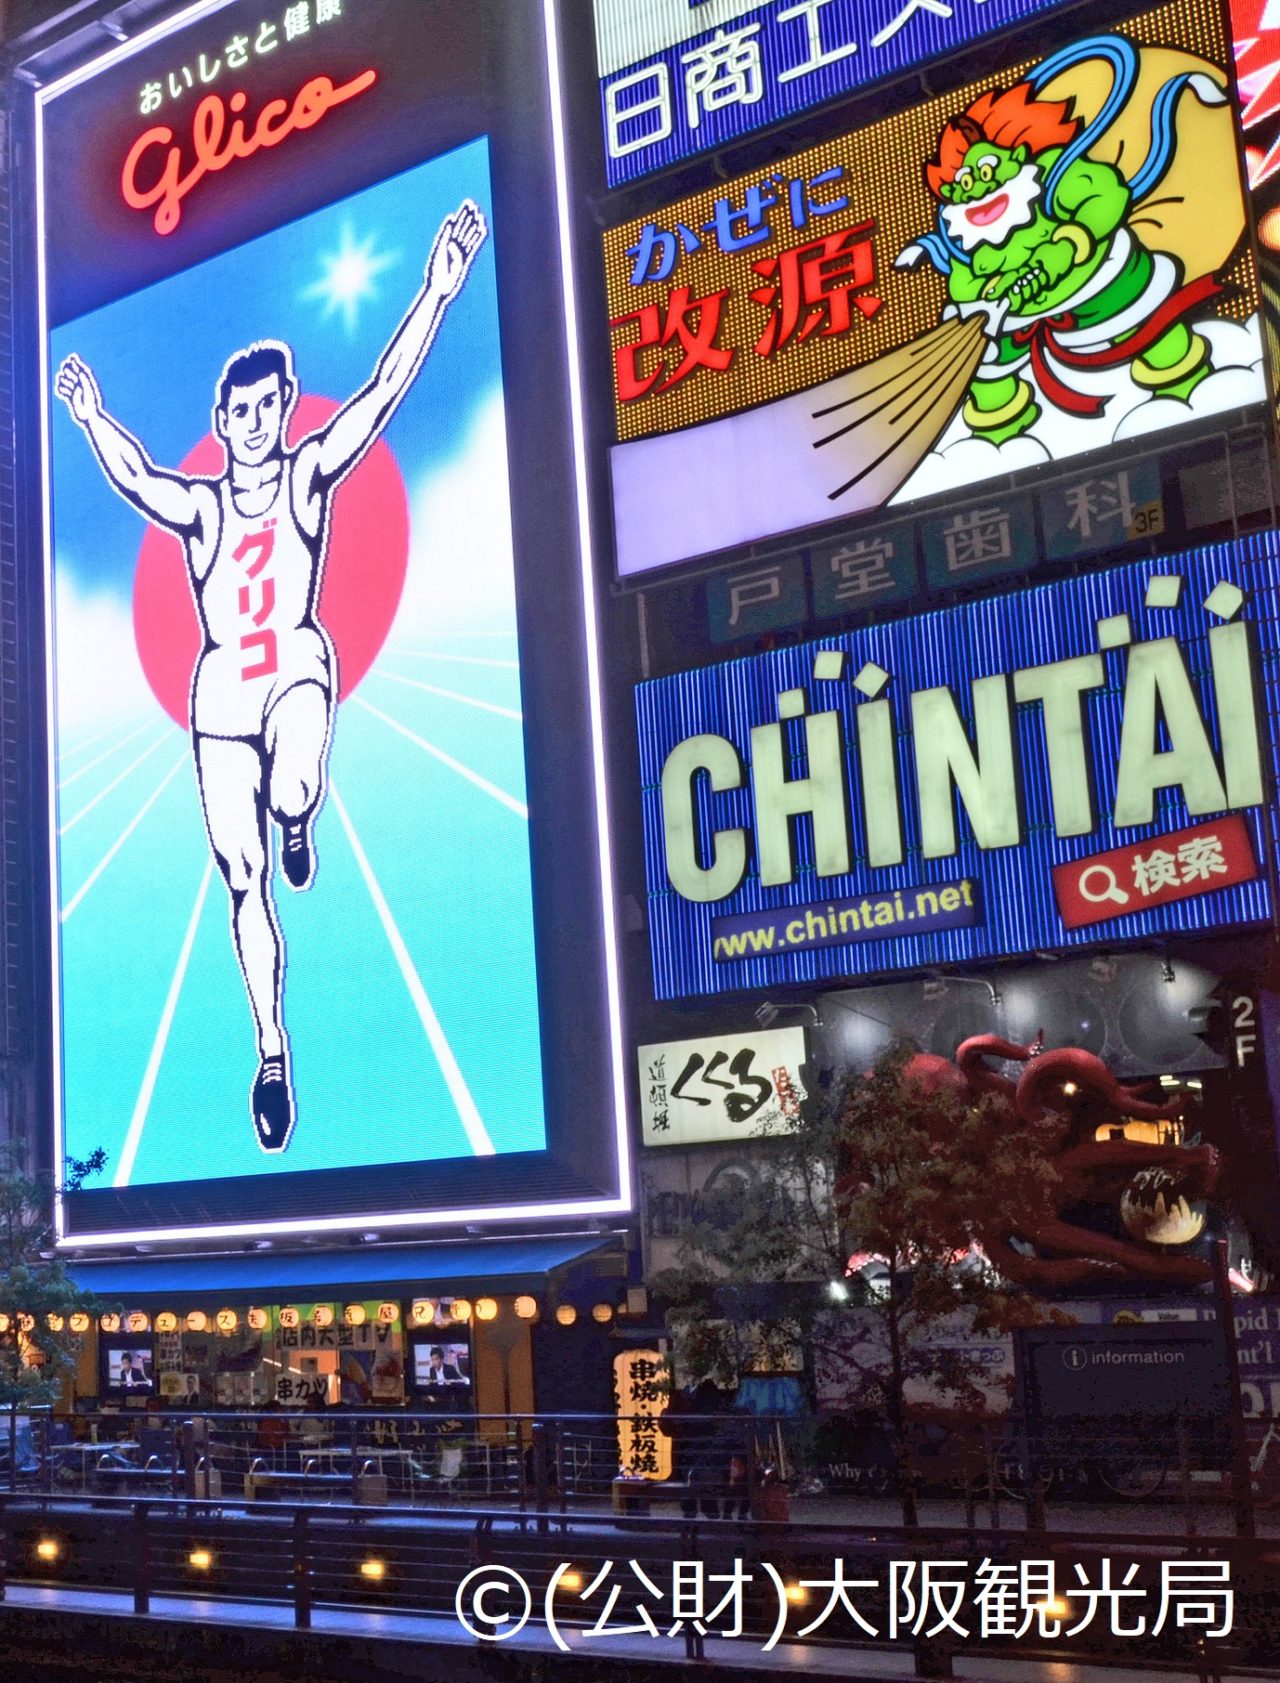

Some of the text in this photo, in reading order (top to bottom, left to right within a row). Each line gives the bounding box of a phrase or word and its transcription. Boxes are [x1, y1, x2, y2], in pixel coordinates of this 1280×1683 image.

[139, 0, 342, 114] おいしさと健康
[121, 69, 376, 235] Glico
[625, 166, 849, 286] かぜに
[609, 218, 883, 402] 改源
[728, 468, 1136, 626] 戸堂歯科
[1135, 507, 1160, 534] 3F
[231, 517, 278, 682] グリコ
[713, 879, 974, 961] ww.chintai.net
[1131, 836, 1229, 898] 検索
[670, 1047, 773, 1124] くくる
[1091, 1350, 1185, 1366] information
